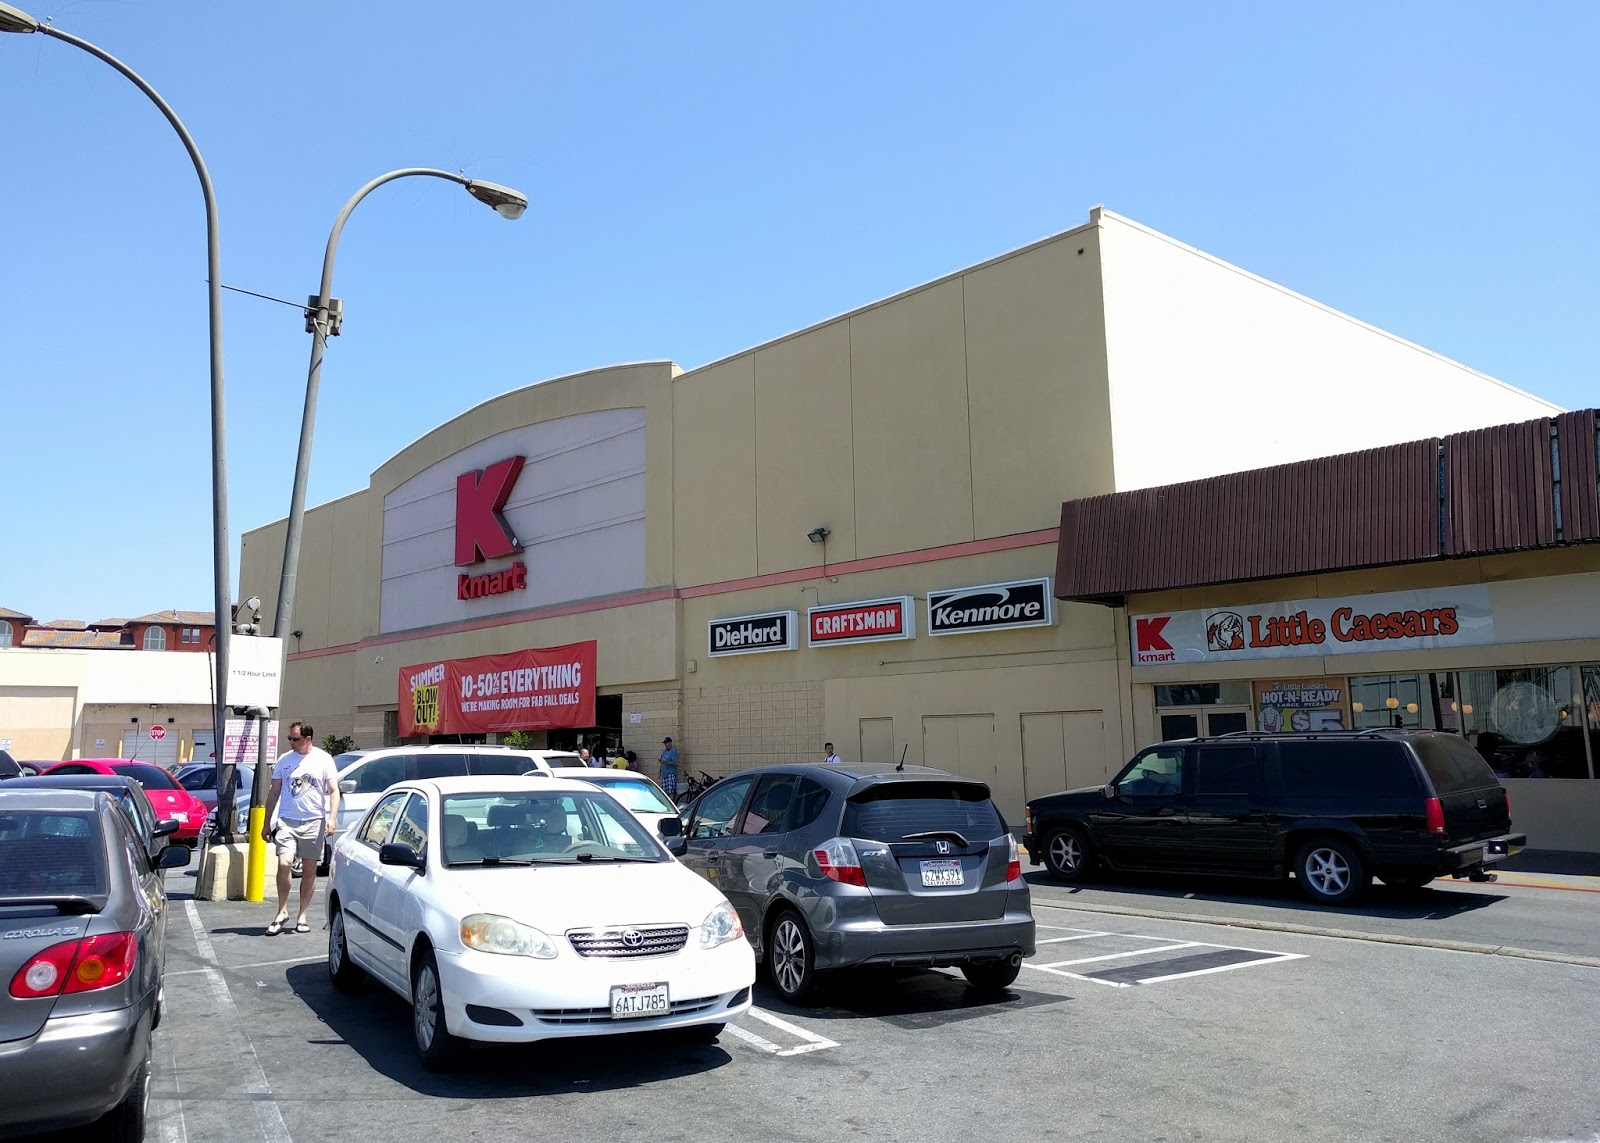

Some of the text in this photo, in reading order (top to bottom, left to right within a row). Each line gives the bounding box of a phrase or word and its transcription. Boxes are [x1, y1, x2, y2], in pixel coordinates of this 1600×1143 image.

[455, 455, 526, 567] K
[457, 561, 527, 600] kmart
[815, 609, 896, 635] CRAFTSMAN
[935, 601, 1040, 625] Kenmore
[715, 619, 782, 647] DieHard
[1136, 616, 1174, 650] K
[1248, 607, 1459, 648] Little Caesars
[1138, 651, 1176, 662] kmart
[410, 663, 445, 692] SUMMER
[500, 662, 582, 694] EVERYTHING
[416, 687, 438, 704] BLOW
[461, 692, 580, 712] WE'RE MAKING ROOM FOR FAB FALL DEALS
[416, 702, 436, 724] OUT!
[4, 927, 61, 939] COROLLA
[615, 993, 666, 1012] 6ATJ785
